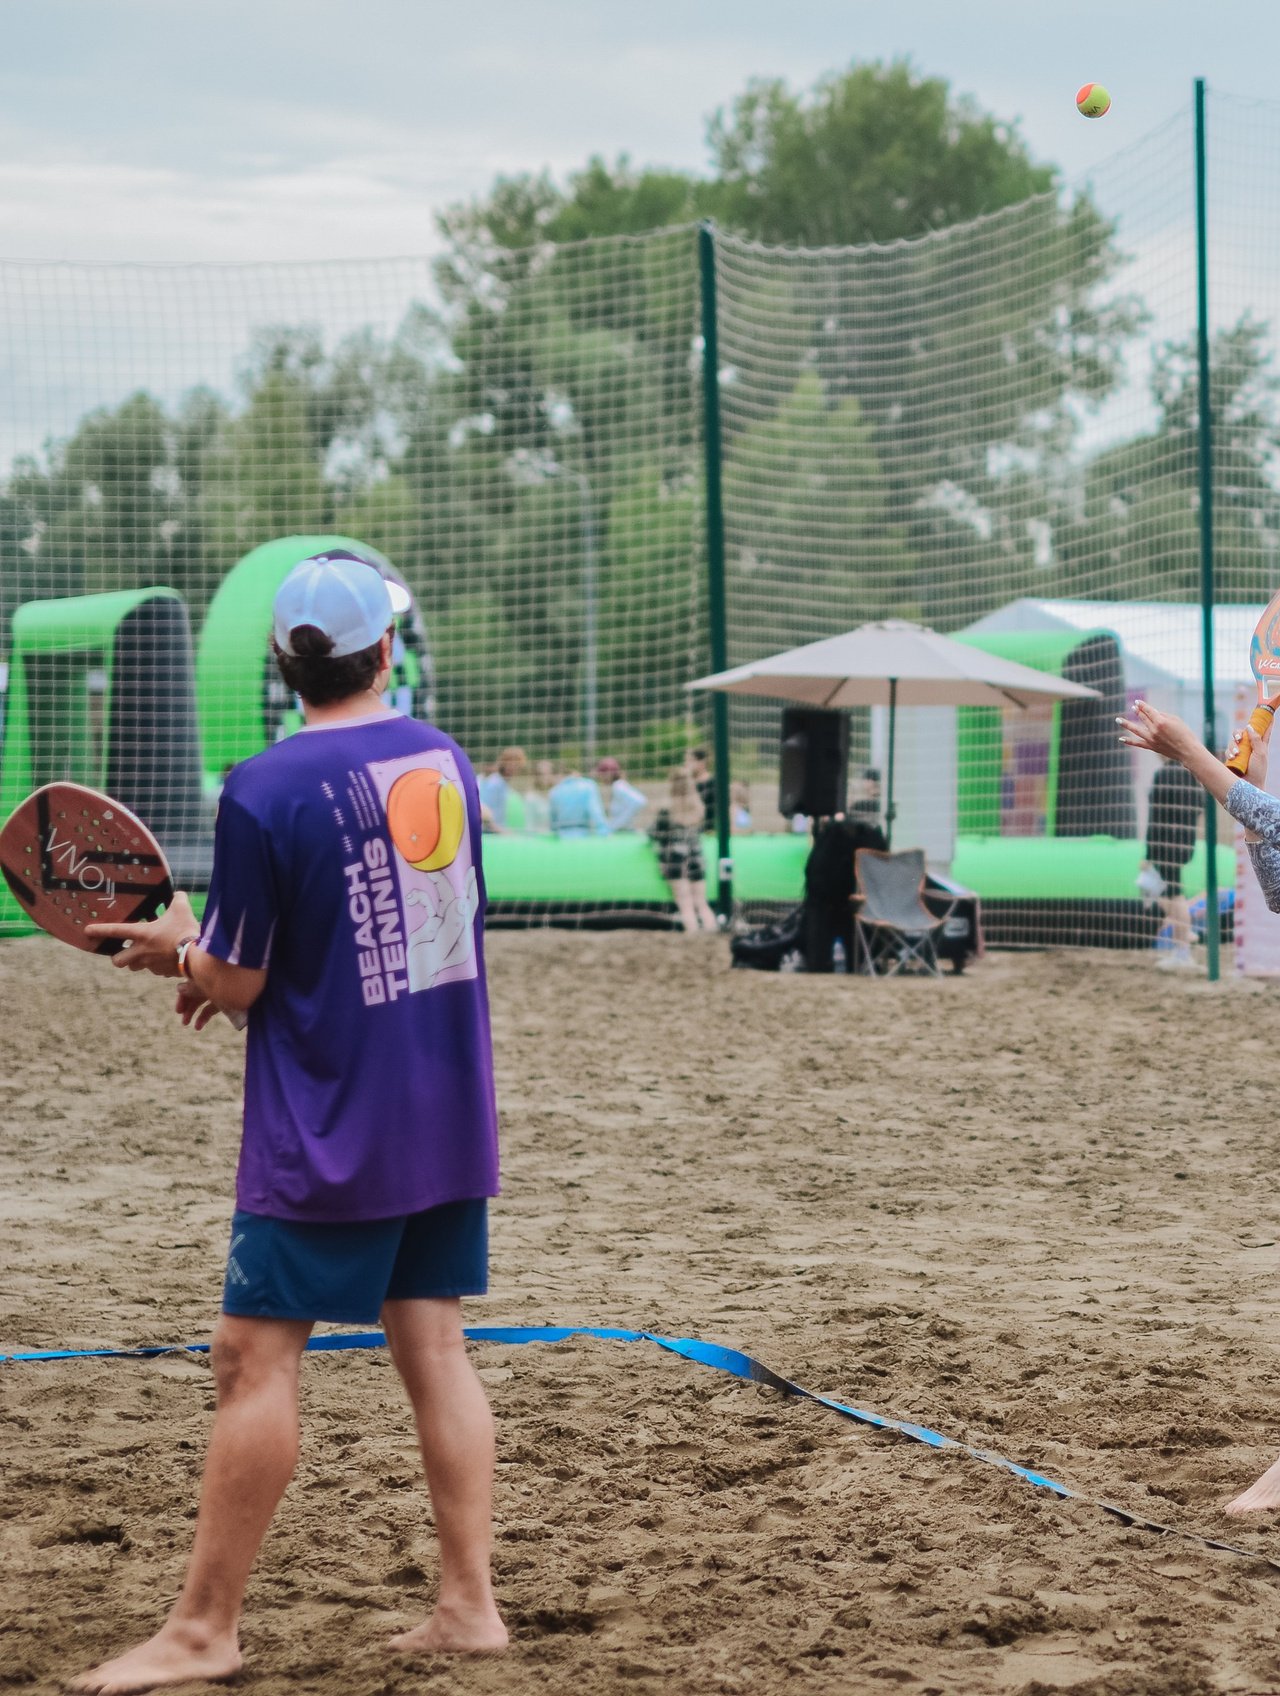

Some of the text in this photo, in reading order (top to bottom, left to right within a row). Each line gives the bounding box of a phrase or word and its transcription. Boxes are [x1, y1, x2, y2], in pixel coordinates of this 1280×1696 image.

[46, 827, 117, 909] KONA
[344, 861, 387, 1006] BEACH
[363, 837, 409, 1002] TENNIS
